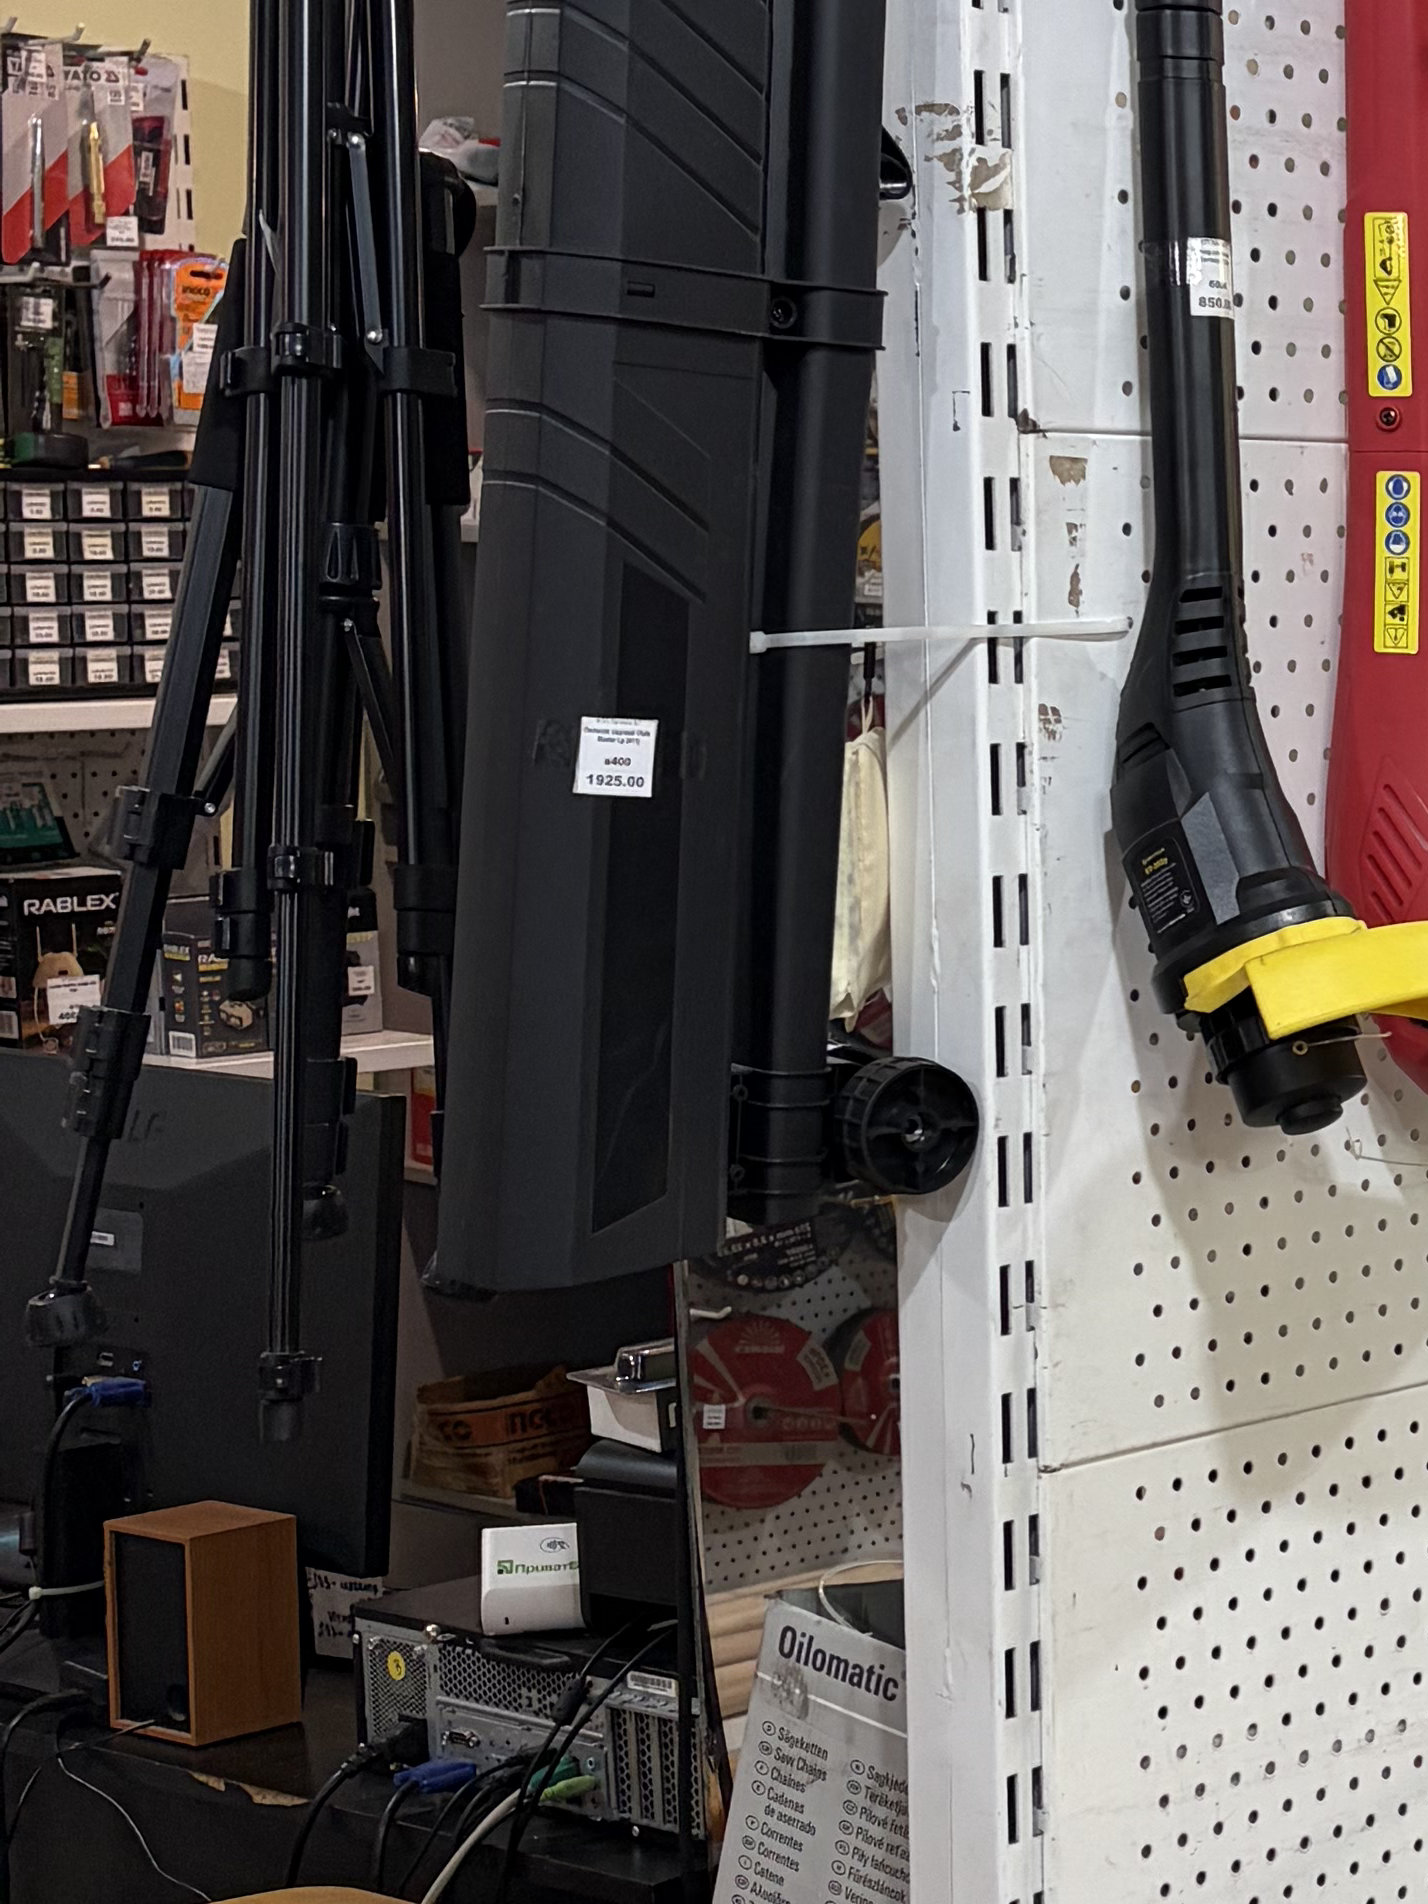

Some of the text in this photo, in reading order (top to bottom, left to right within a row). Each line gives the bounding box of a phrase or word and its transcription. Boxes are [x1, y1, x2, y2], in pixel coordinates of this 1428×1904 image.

[586, 773, 645, 788] 1925.00
[23, 893, 117, 916] RABLEX
[778, 1624, 899, 1702] Oilomatic
[774, 1746, 796, 1768] Saw
[778, 1726, 829, 1761] Sägeketten
[760, 1822, 803, 1852] Correntes
[757, 1842, 800, 1872] Correntes
[753, 1861, 785, 1887] Catene
